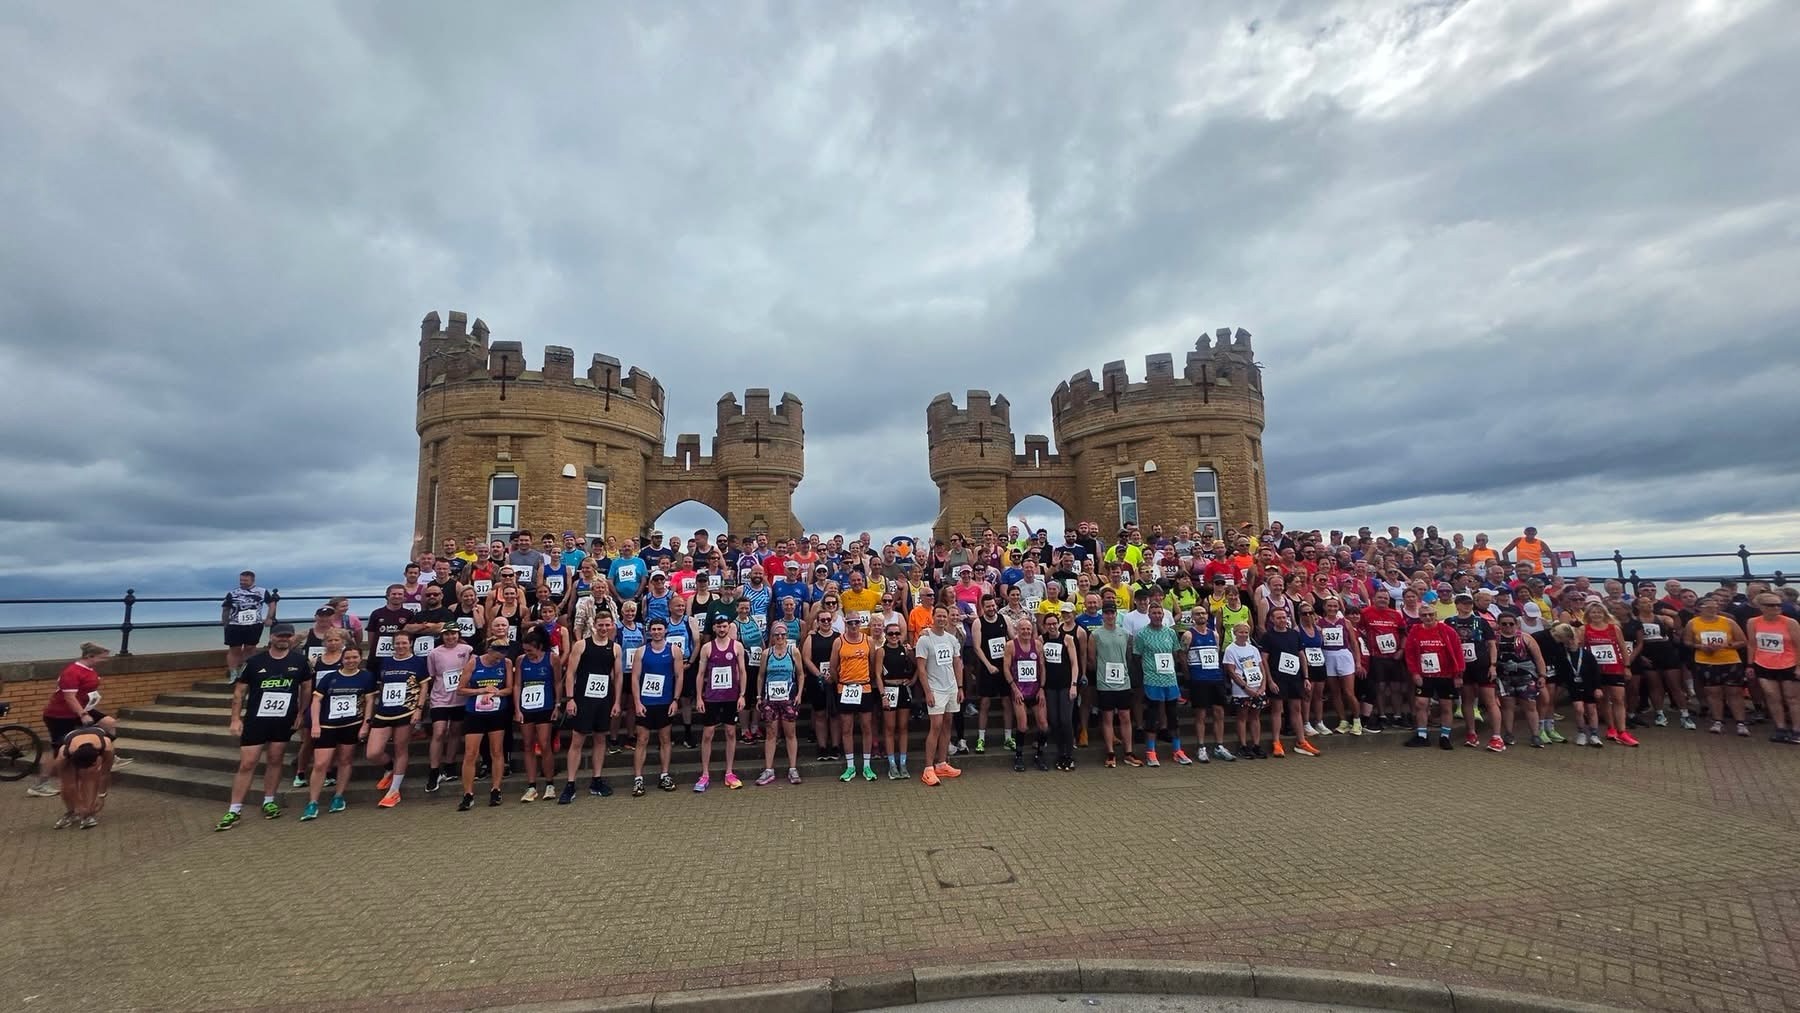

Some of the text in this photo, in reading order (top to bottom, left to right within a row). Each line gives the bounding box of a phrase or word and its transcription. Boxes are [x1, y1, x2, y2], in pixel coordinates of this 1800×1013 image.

[938, 650, 950, 659] 222
[1161, 660, 1169, 668] 57
[1285, 660, 1294, 668] 35
[715, 674, 728, 683] 211
[1111, 669, 1119, 678] 51
[261, 679, 293, 689] BERLIN
[590, 681, 605, 691] 326
[646, 681, 660, 691] 248
[386, 689, 401, 699] 184
[525, 692, 541, 702] 217
[845, 689, 858, 697] 320
[263, 700, 285, 710] 342
[336, 701, 349, 711] 33
